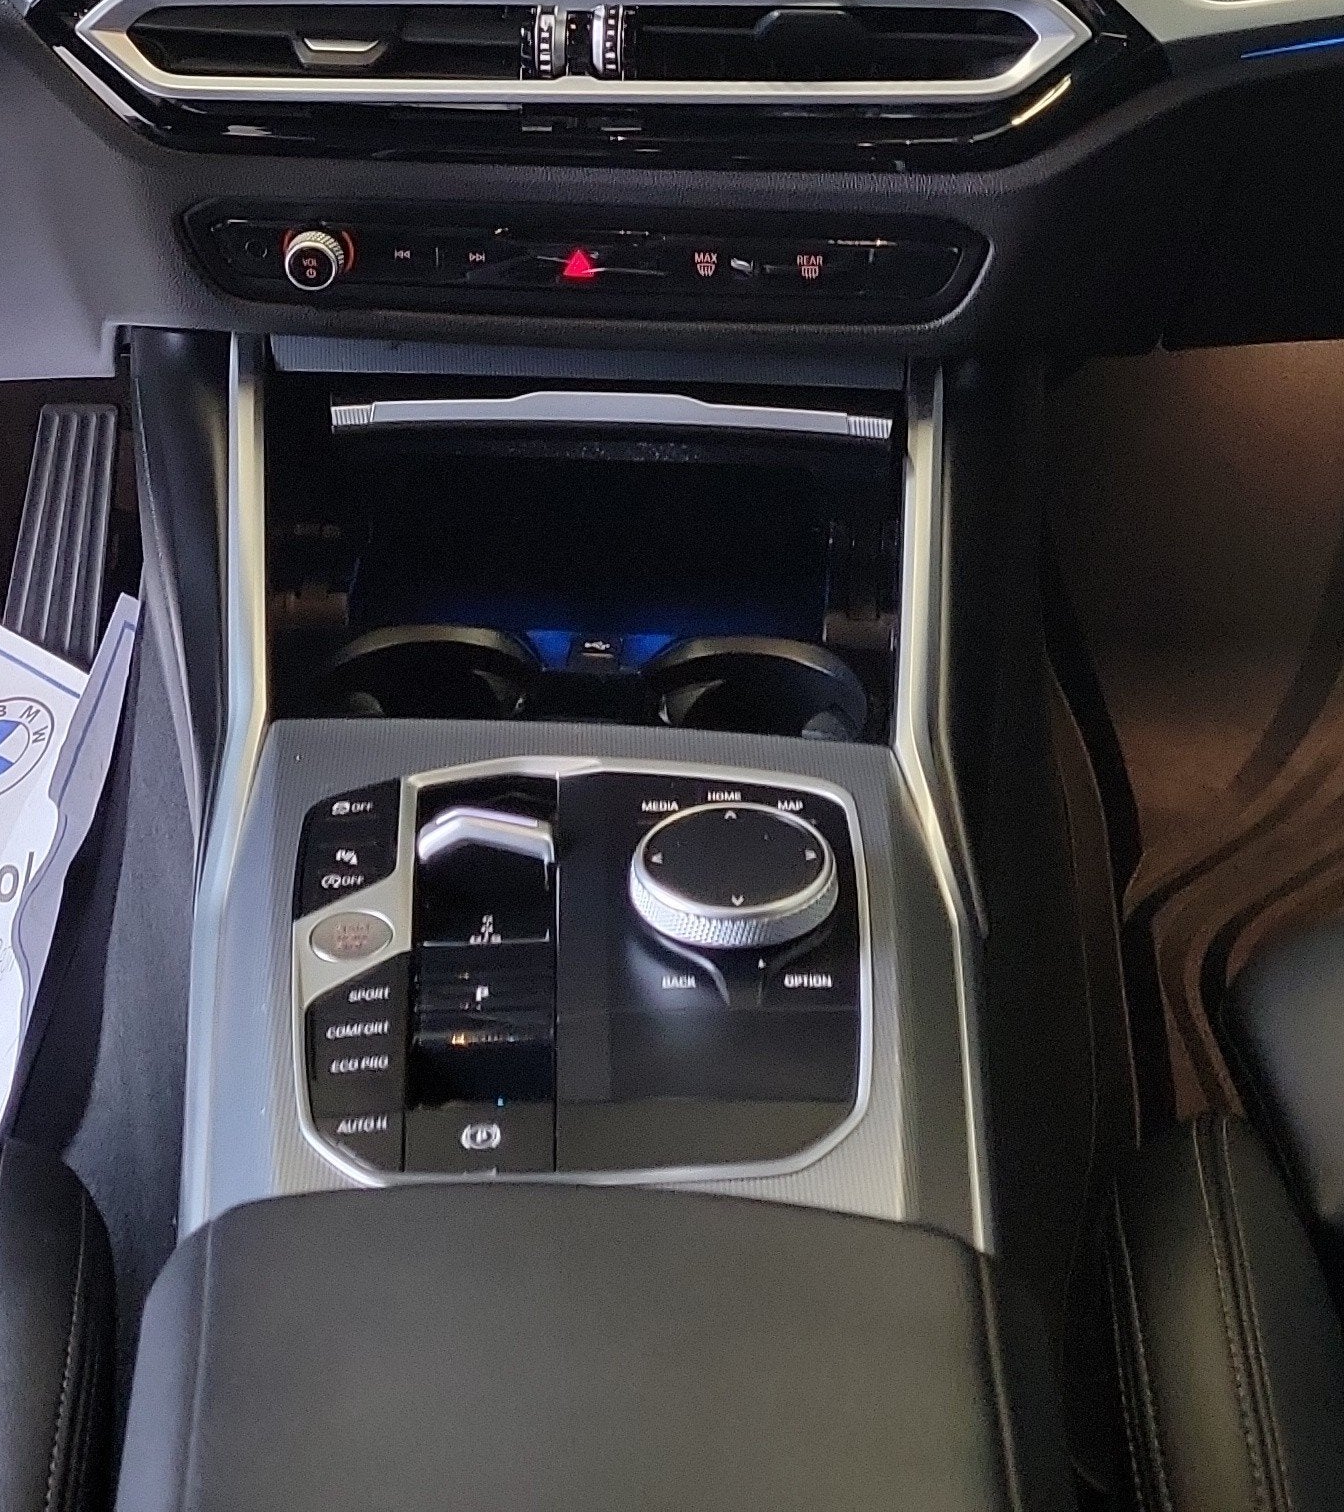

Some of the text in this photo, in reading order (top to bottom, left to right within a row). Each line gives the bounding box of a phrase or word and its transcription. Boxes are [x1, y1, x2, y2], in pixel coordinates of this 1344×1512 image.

[694, 251, 718, 264] MAX
[796, 254, 824, 267] REAR
[707, 790, 742, 802] HOME
[351, 801, 374, 814] OFF
[641, 800, 679, 812] MEDIA
[777, 799, 804, 812] MAP
[341, 875, 365, 887] OFF
[661, 974, 697, 989] BACK
[783, 973, 833, 989] OPTION
[348, 987, 391, 1003] SPORT
[325, 1019, 391, 1040] COMFORT
[330, 1055, 390, 1074] ECO PRO
[337, 1116, 375, 1134] AUTO
